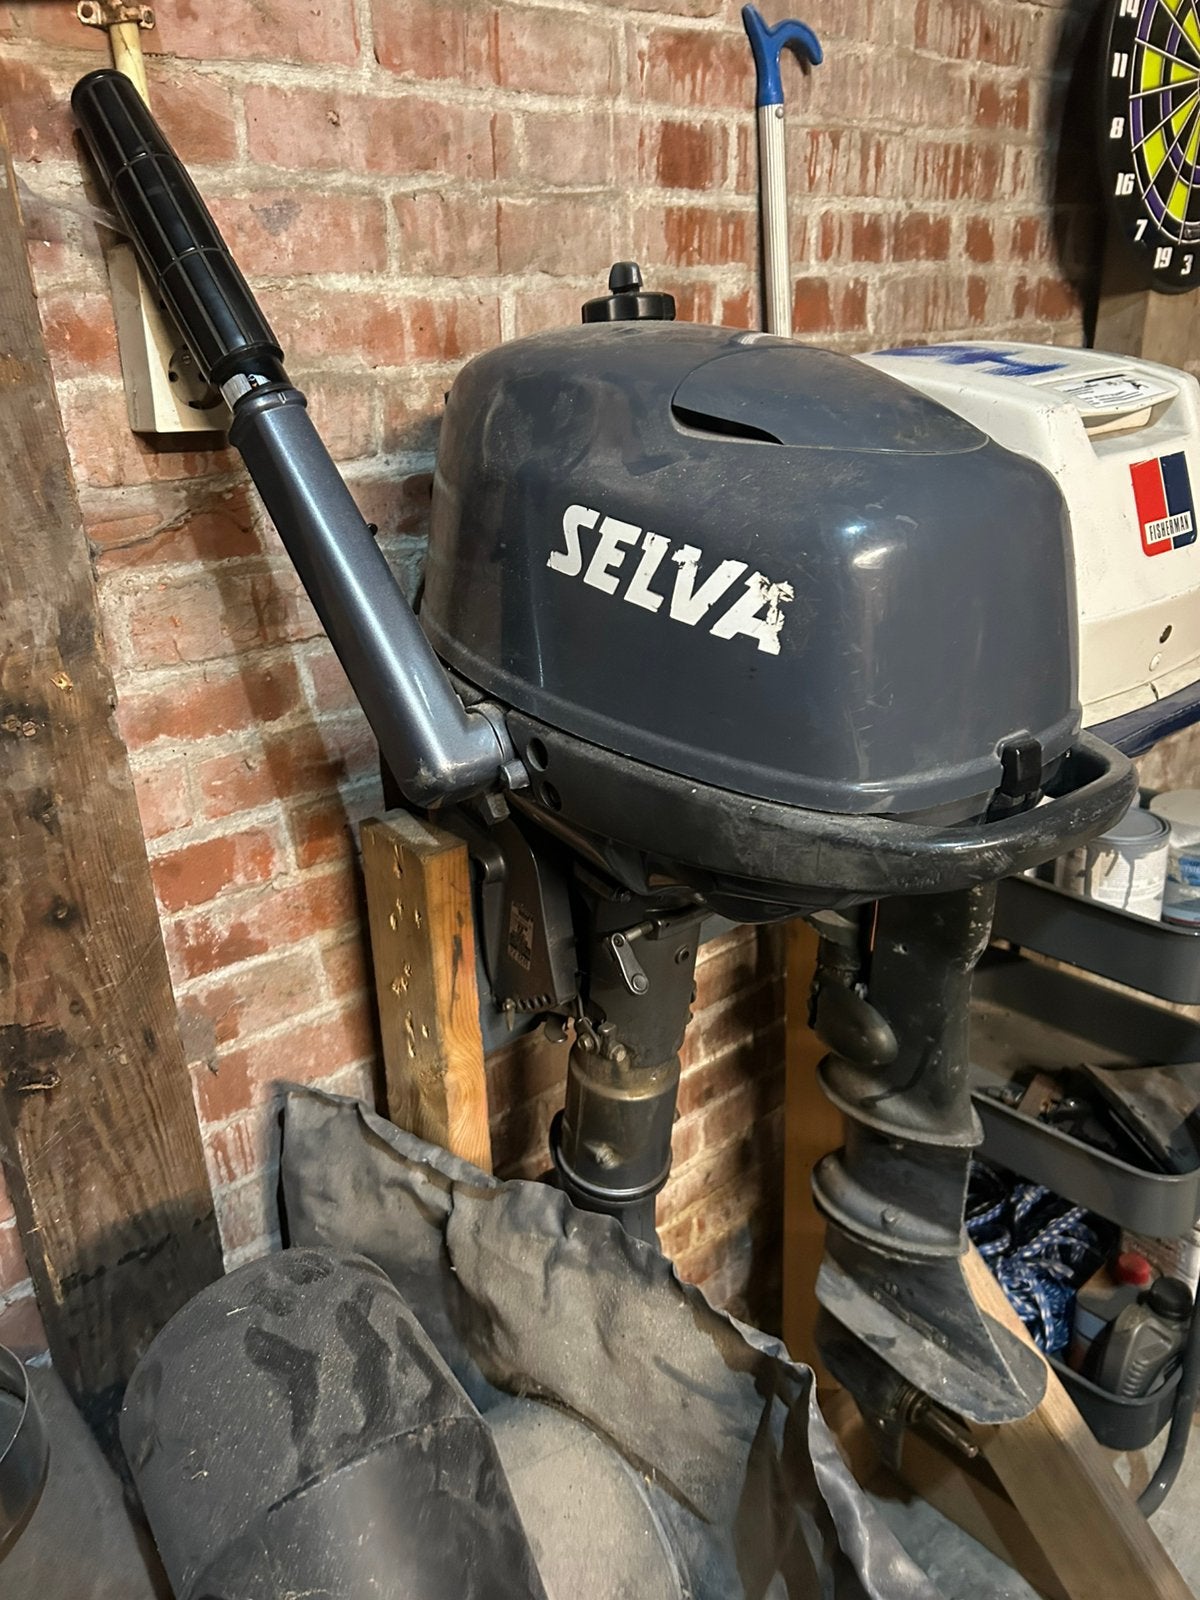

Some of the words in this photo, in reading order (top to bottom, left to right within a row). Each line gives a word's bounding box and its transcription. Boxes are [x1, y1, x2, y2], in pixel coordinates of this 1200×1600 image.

[1120, 0, 1140, 17] 14
[1112, 53, 1128, 77] 11
[1110, 117, 1125, 138] 8
[1115, 173, 1135, 195] 16
[1134, 219, 1148, 241] 7
[1154, 247, 1173, 268] 19
[1181, 255, 1193, 275] 3
[1149, 515, 1189, 541] FISHERMAN
[547, 504, 794, 655] SELVA
